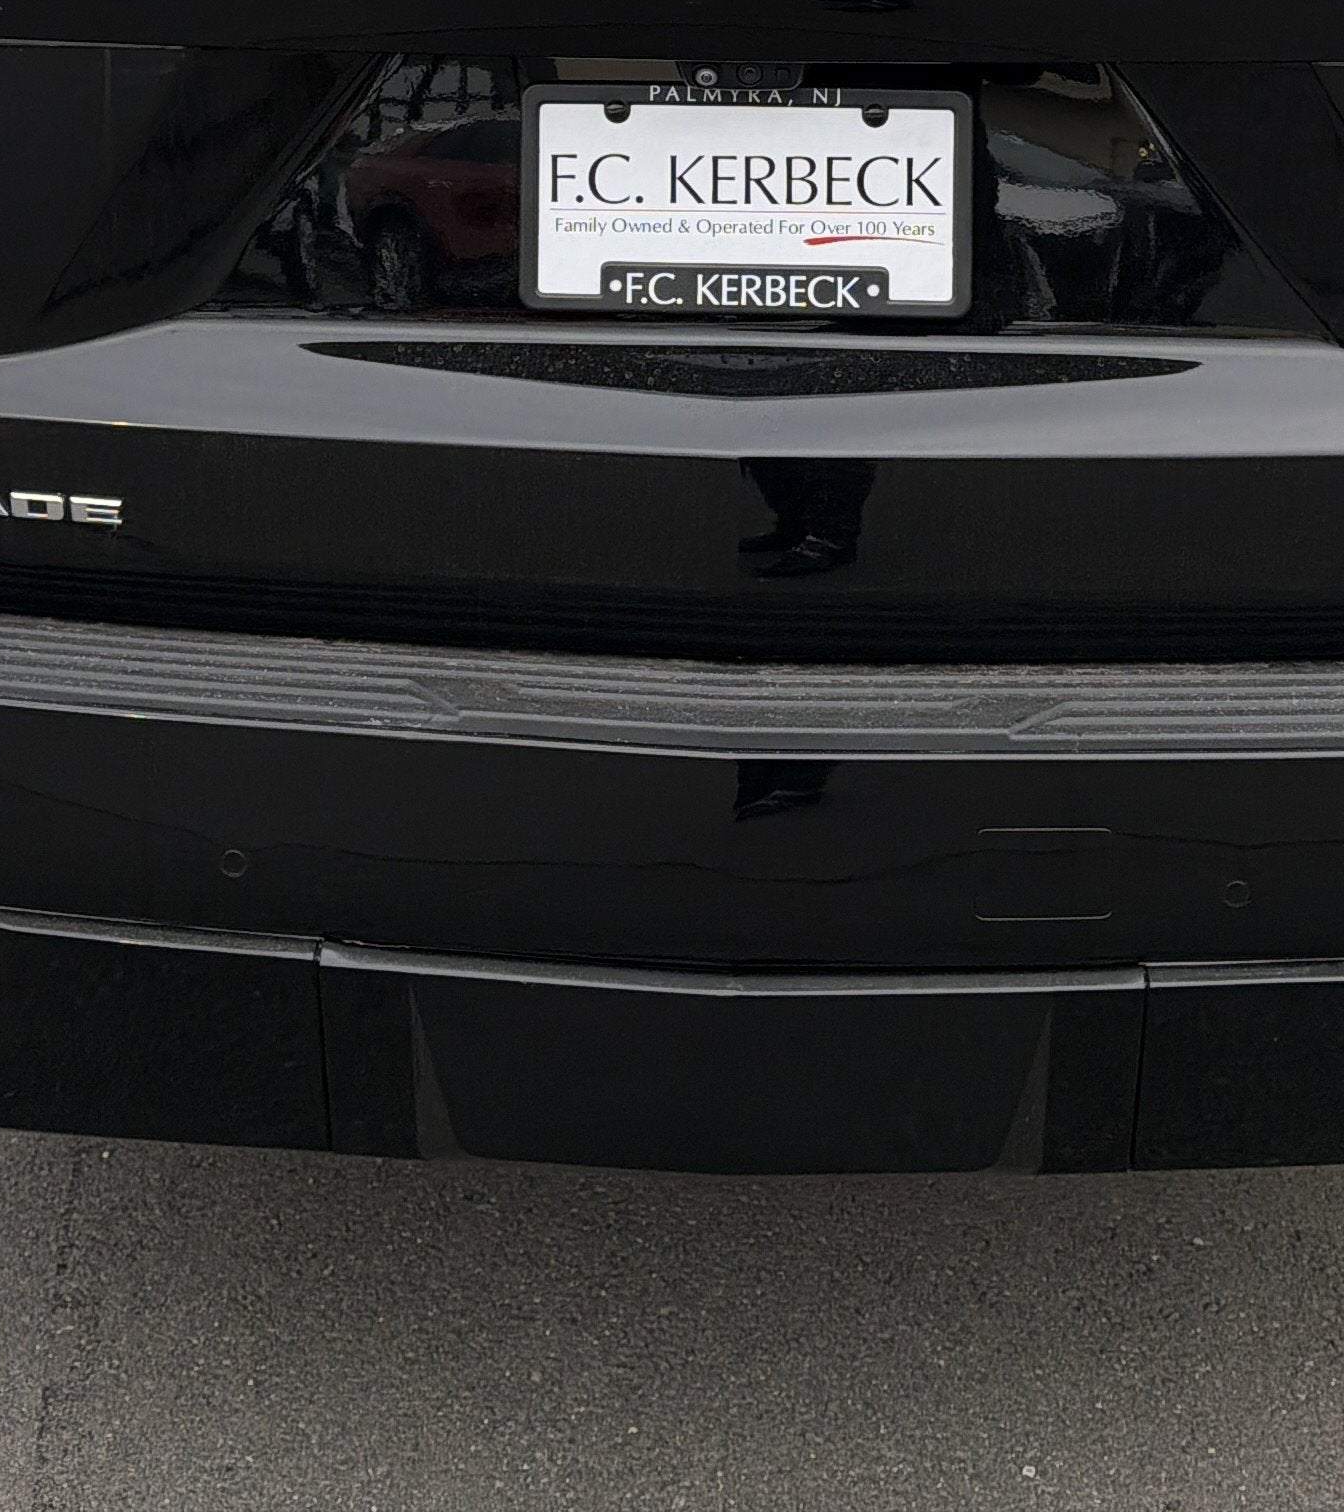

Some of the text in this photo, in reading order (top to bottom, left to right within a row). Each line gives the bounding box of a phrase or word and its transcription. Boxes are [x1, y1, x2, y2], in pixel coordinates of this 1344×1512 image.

[812, 87, 841, 107] NJ
[550, 153, 944, 208] F.C. KERBECK
[554, 217, 936, 237] Family Owned & Operated For Over 100 Years
[625, 272, 861, 309] F.C. KERBECK
